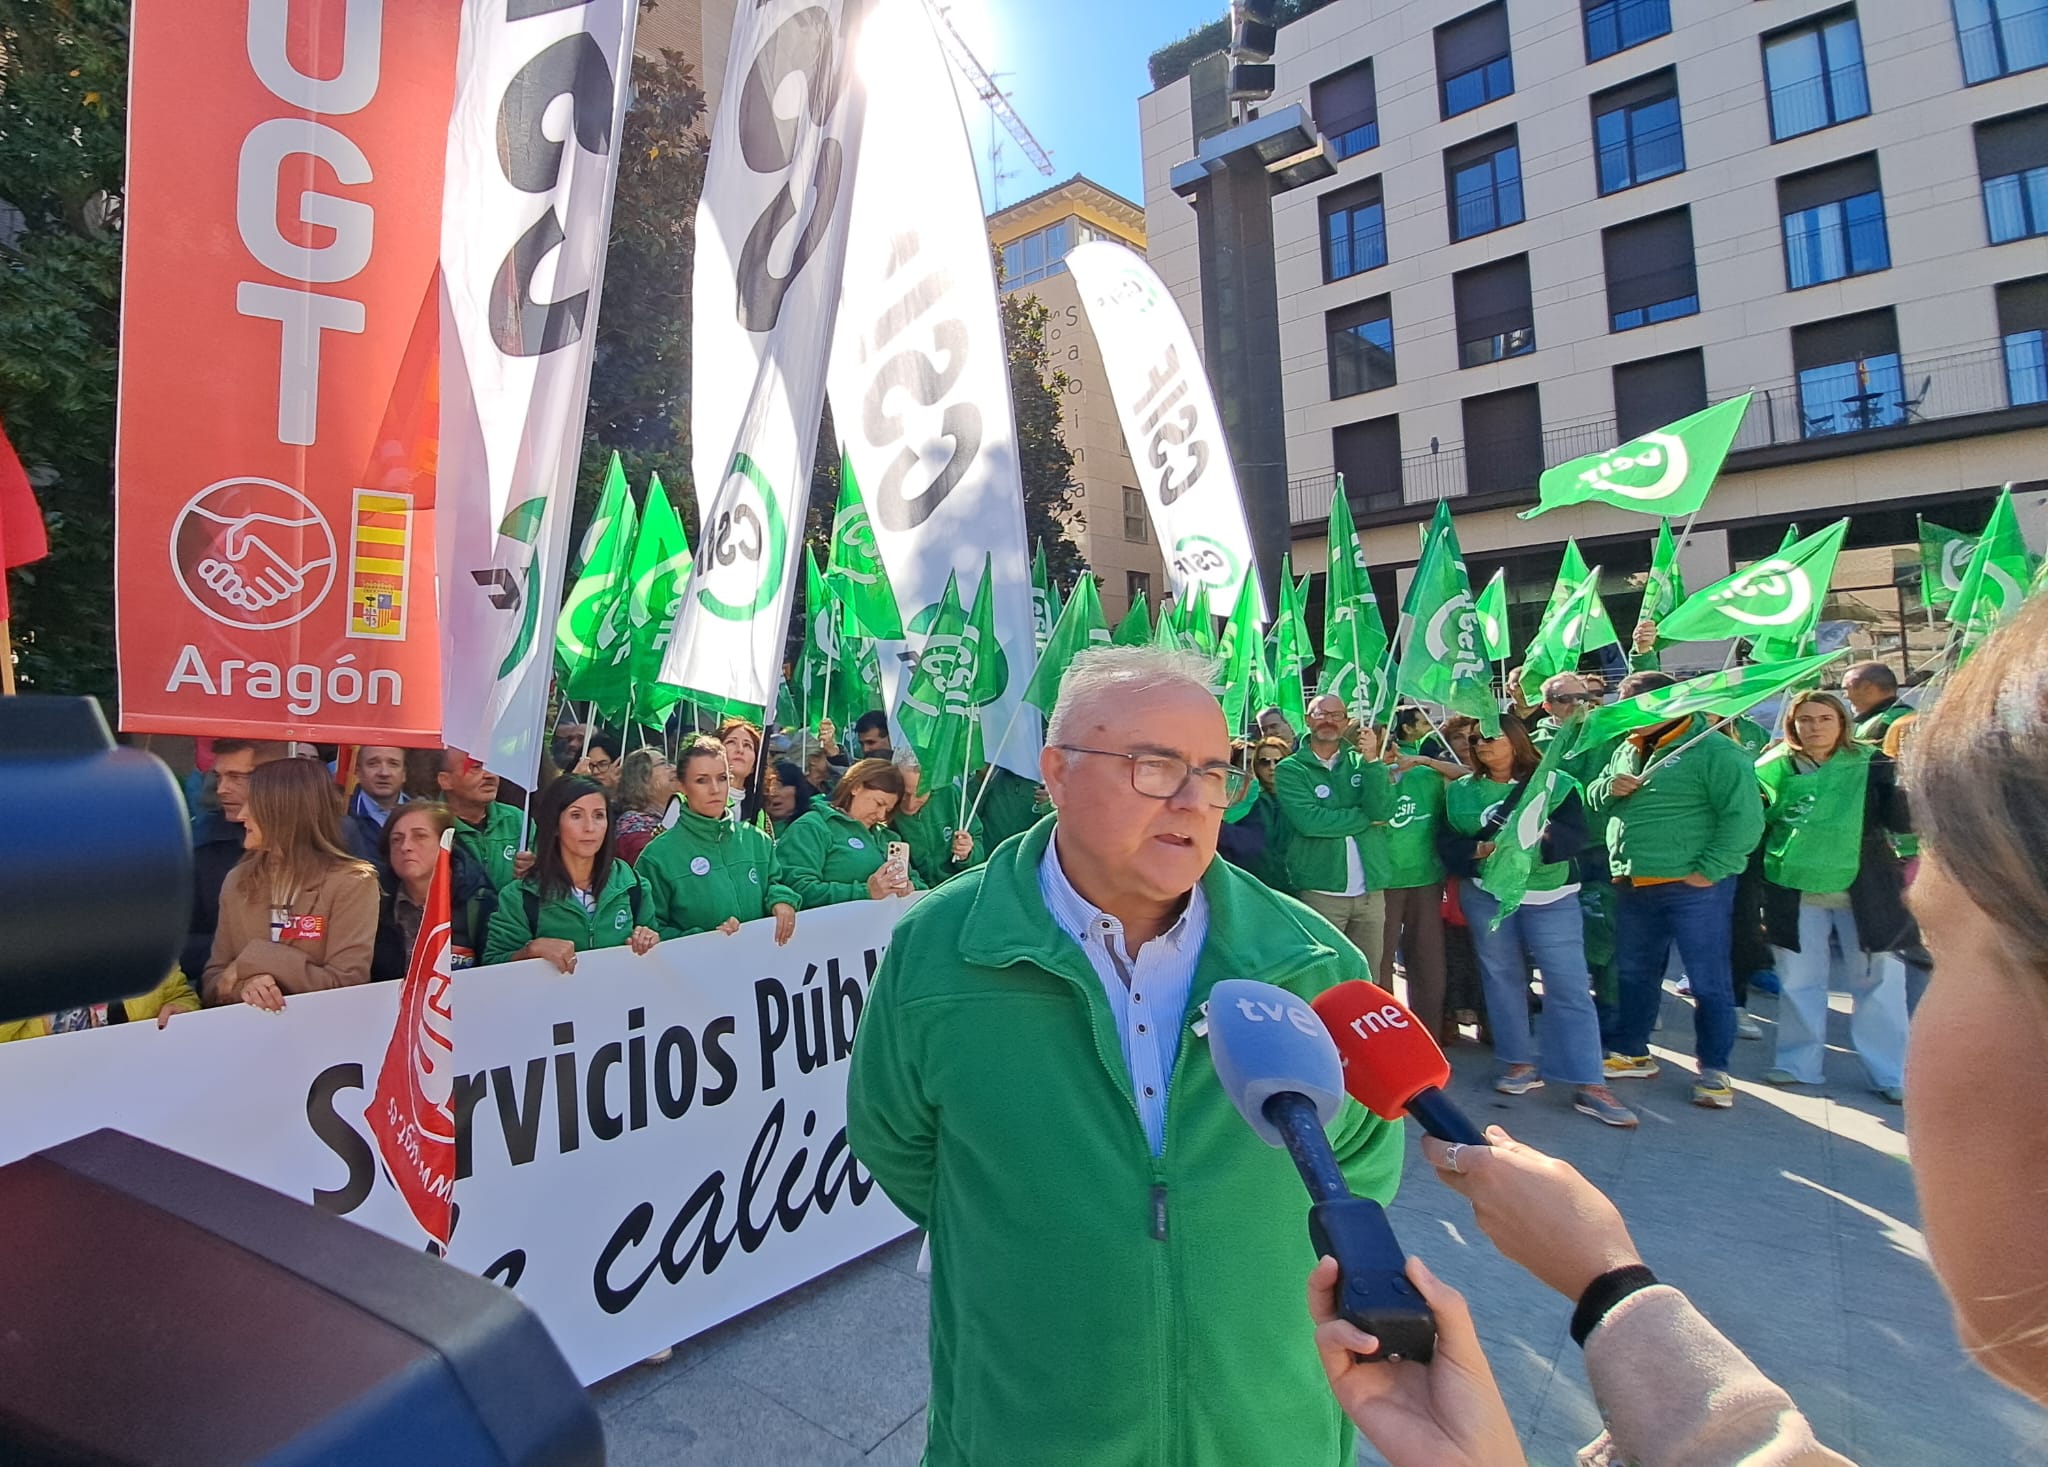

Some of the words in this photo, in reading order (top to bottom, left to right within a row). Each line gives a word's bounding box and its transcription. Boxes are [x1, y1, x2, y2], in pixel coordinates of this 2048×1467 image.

[237, 0, 382, 446] UGT
[165, 643, 404, 718] Aragón
[1235, 997, 1319, 1038] tve
[1350, 1004, 1410, 1040] rne
[306, 1006, 738, 1216] Srvicios
